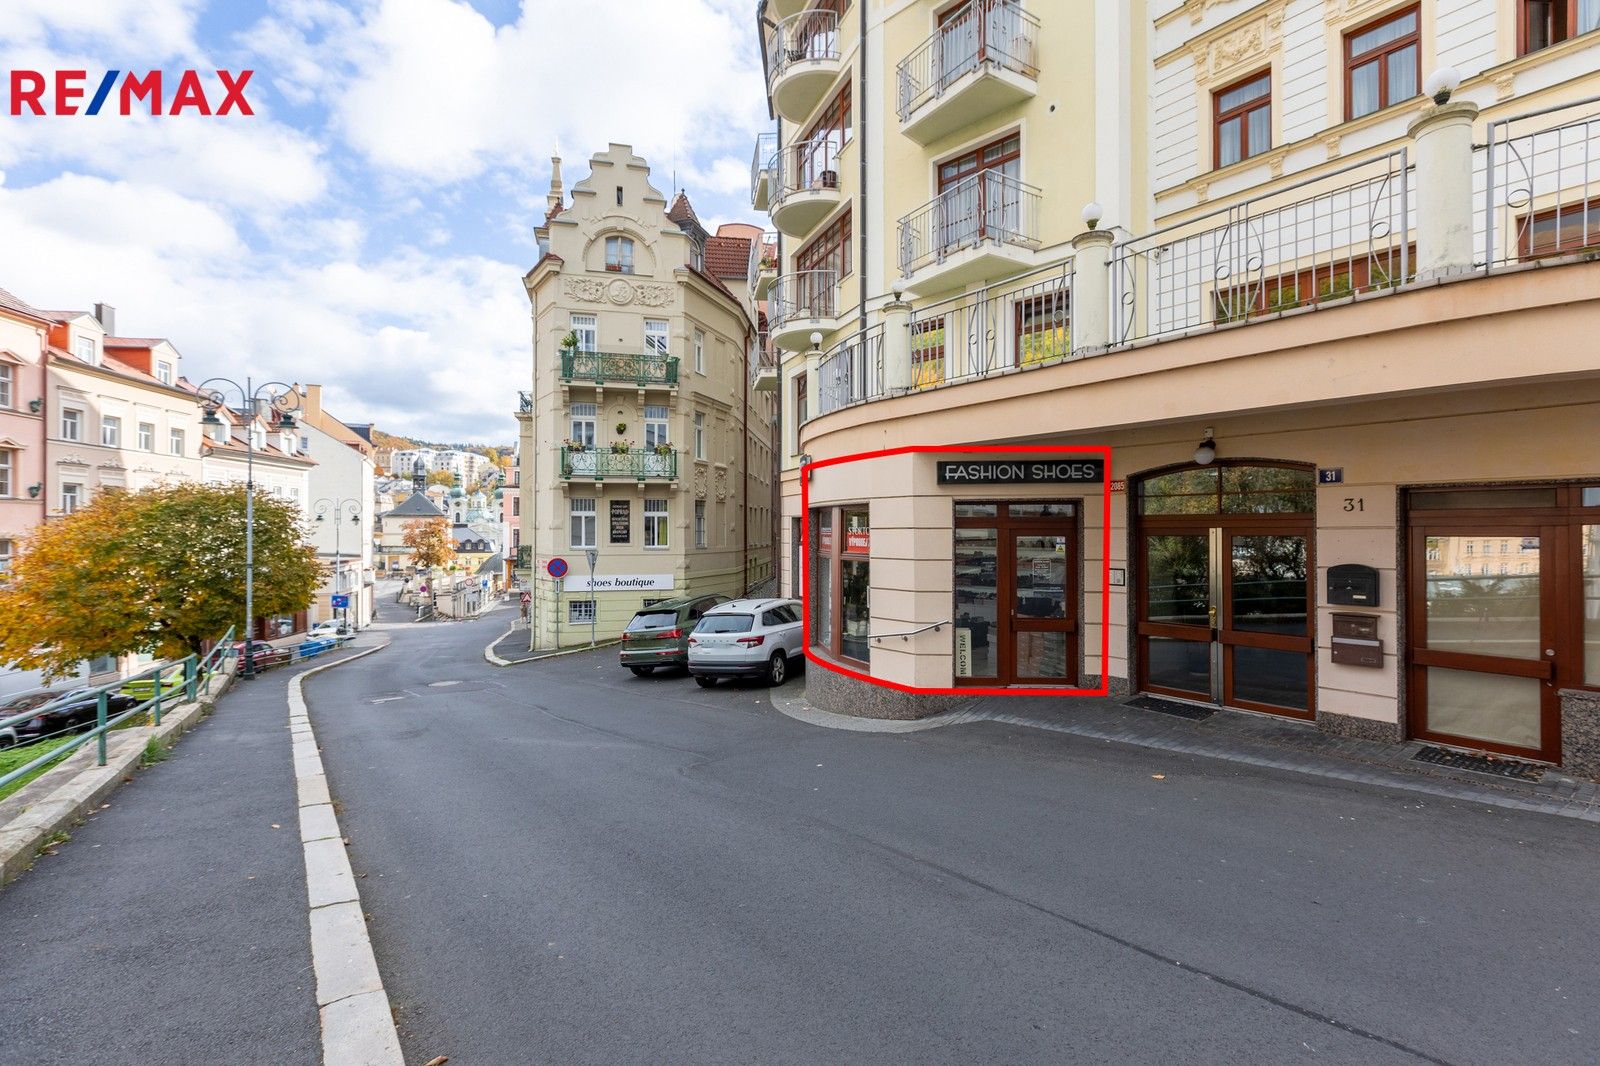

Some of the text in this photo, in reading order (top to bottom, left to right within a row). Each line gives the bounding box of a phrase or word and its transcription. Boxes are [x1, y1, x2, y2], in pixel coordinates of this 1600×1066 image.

[945, 464, 1095, 480] FASHION SHOES
[1325, 471, 1336, 481] 31
[1343, 498, 1365, 512] 31
[586, 577, 655, 588] shoes boutique
[959, 634, 967, 677] WELCOM
